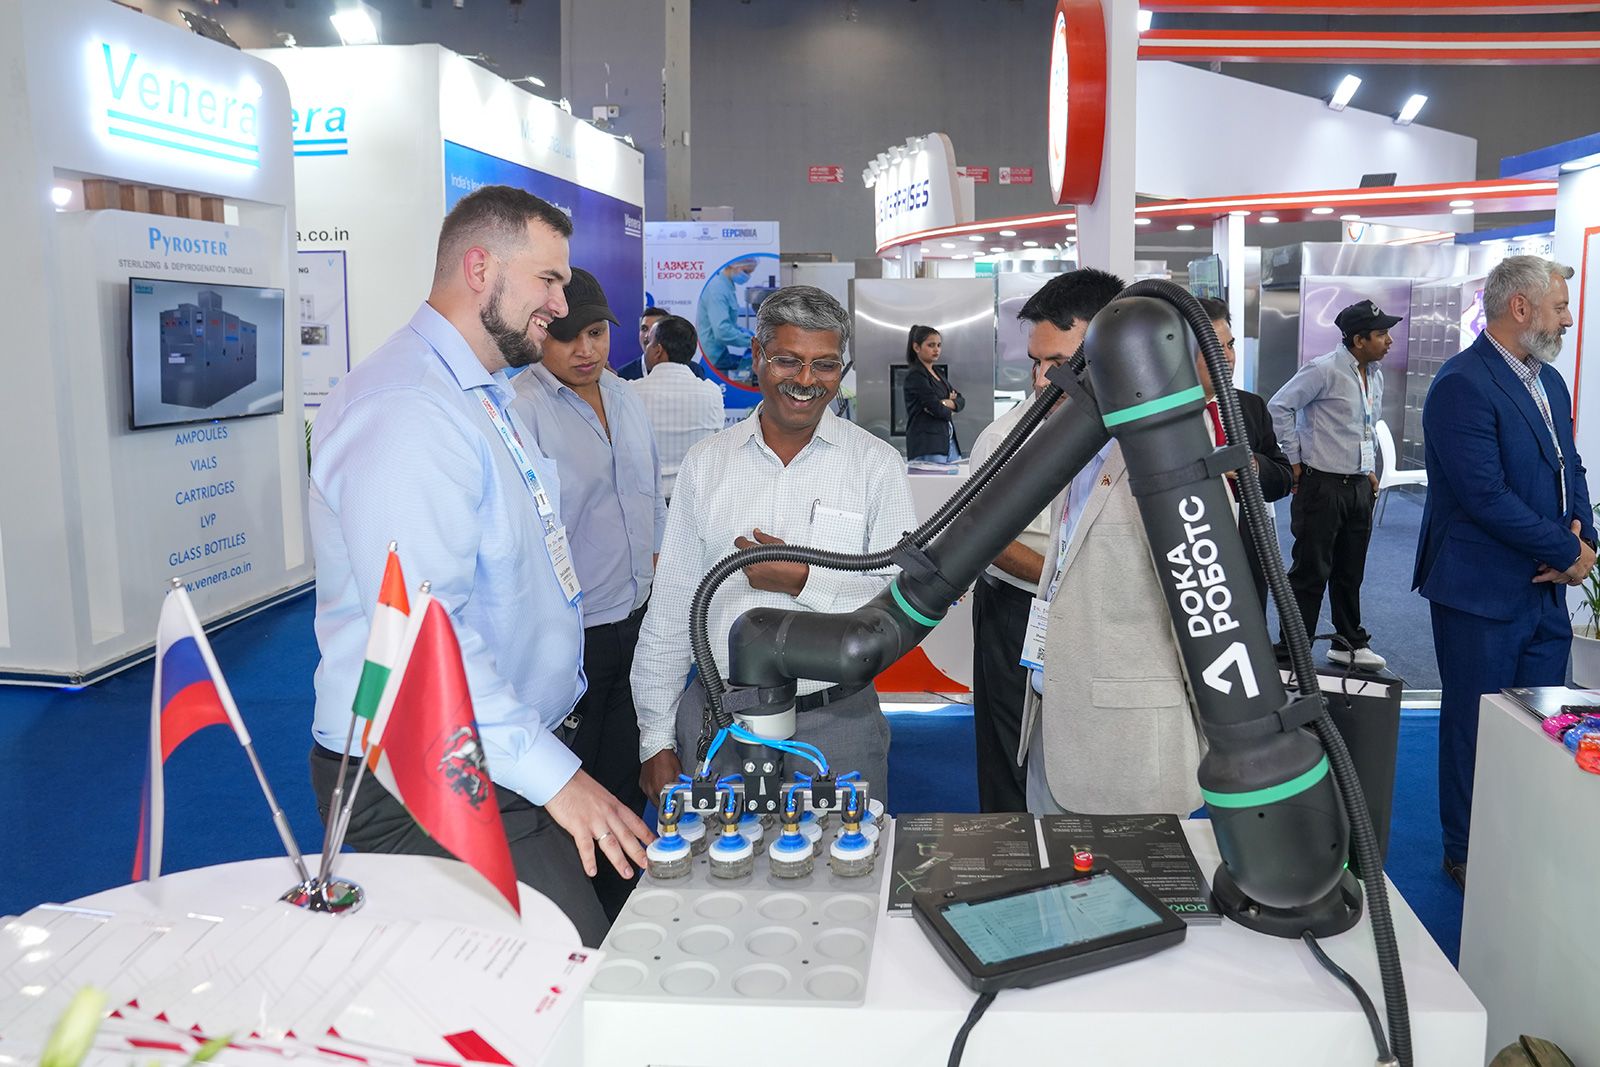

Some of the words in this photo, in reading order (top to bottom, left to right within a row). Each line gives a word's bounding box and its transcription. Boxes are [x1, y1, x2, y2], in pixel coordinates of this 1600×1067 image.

[102, 43, 258, 136] Venera
[624, 212, 641, 230] Venera
[118, 259, 162, 270] STERILIZING
[164, 261, 170, 270] &
[171, 262, 227, 273] DEPYROGENATION
[227, 266, 254, 275] TUNNELS
[657, 260, 705, 271] LABNEXT
[657, 272, 682, 280] EXPO
[683, 272, 706, 280] 2026
[175, 426, 228, 446] AMPOULES
[190, 456, 217, 472] VIALS
[175, 480, 235, 505] CARTRIDGES
[200, 513, 216, 528] LVP
[168, 546, 202, 566] GLASS
[166, 561, 252, 595] w.venera.co.in
[1166, 542, 1213, 638] DOKA
